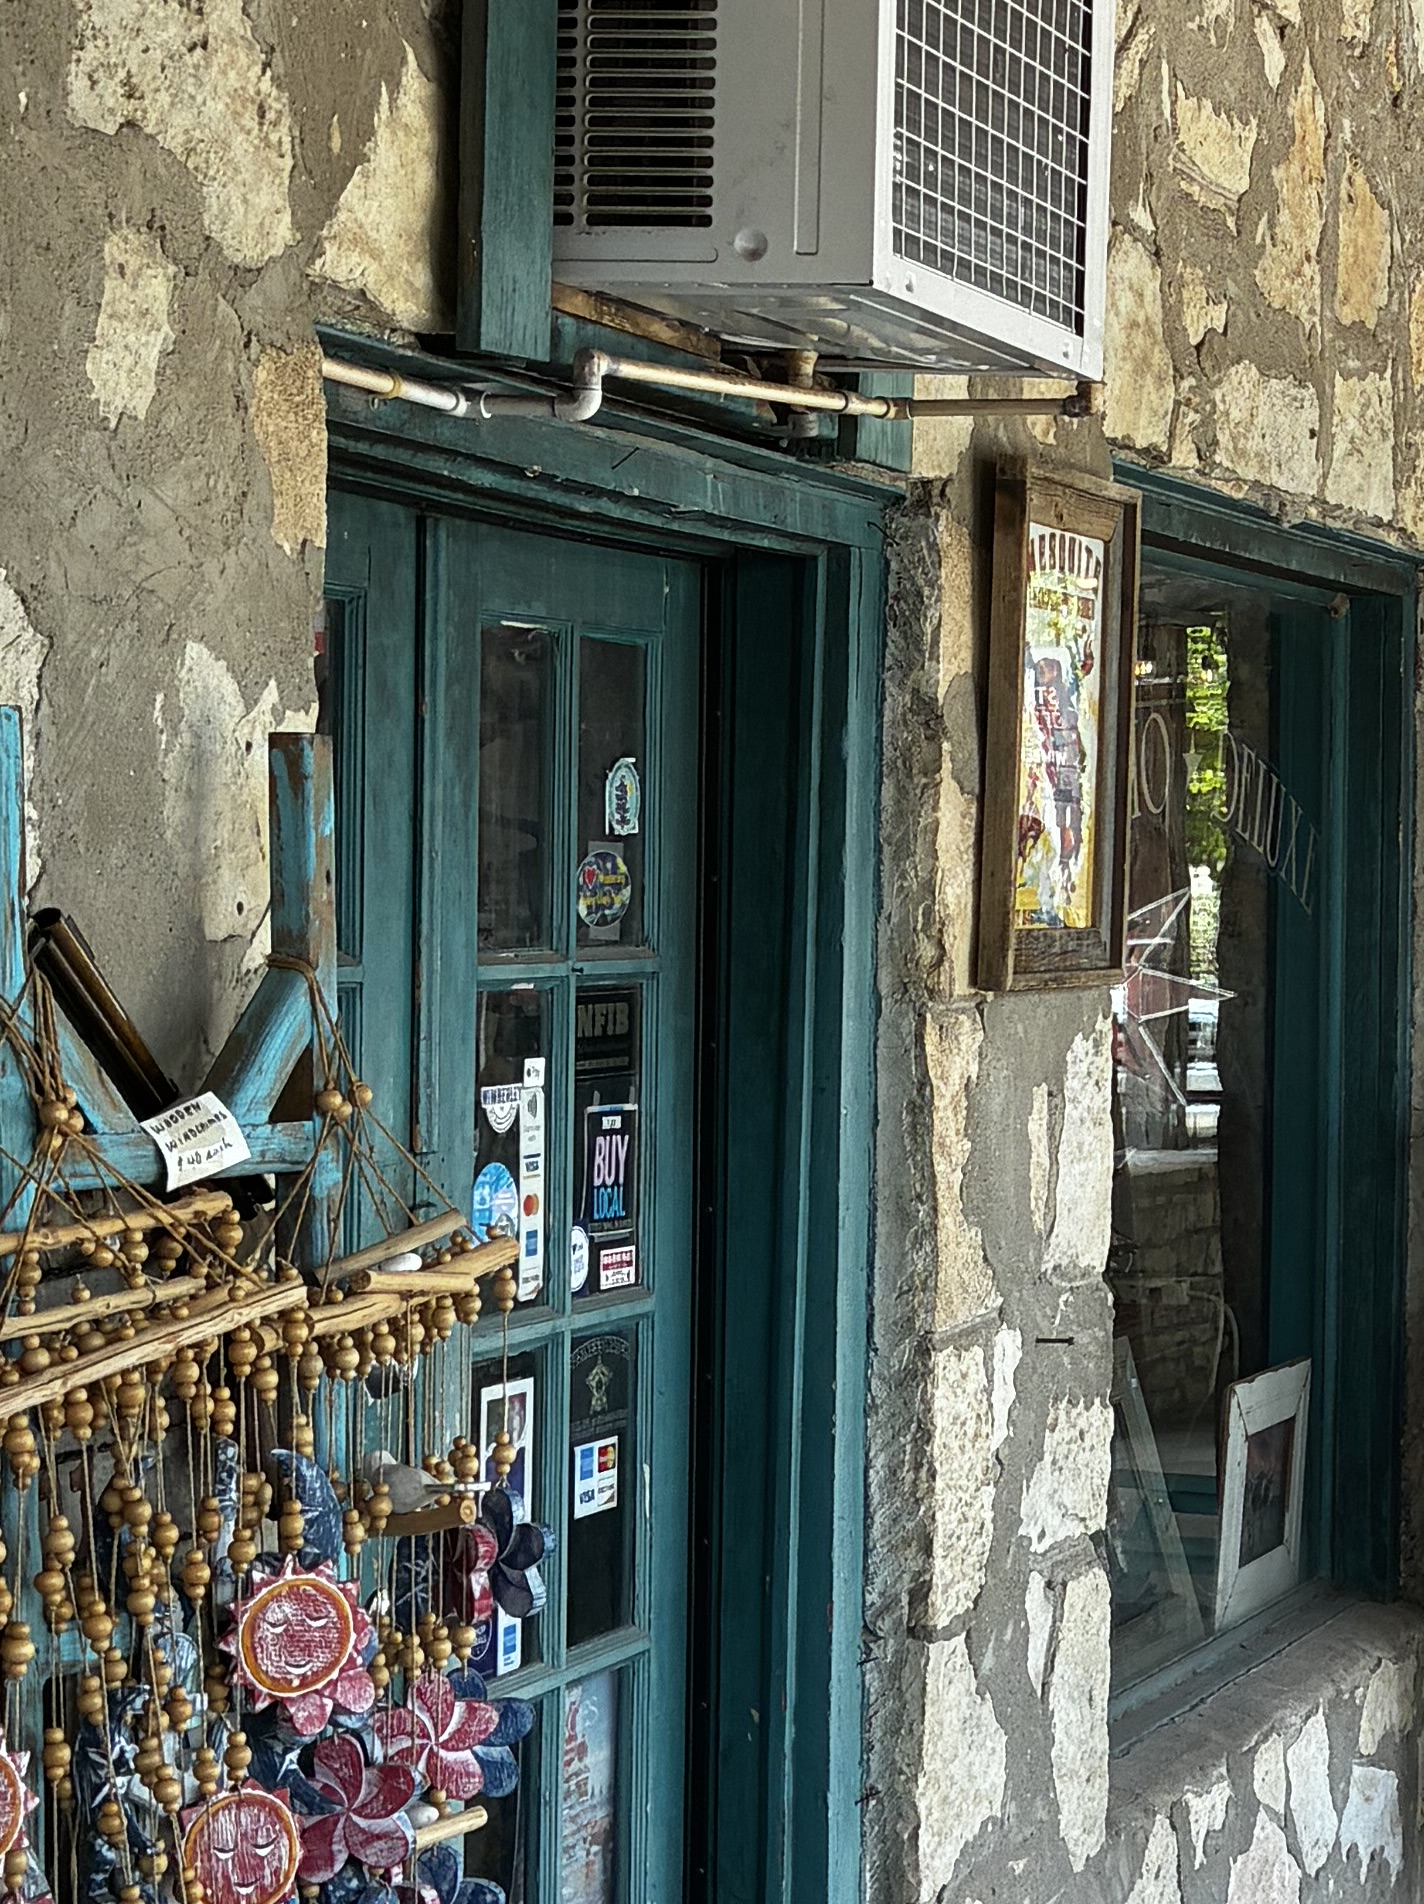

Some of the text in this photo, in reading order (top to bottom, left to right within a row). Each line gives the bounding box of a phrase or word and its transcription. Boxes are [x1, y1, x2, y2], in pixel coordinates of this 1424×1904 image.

[1210, 730, 1321, 920] DELUXE
[576, 1002, 630, 1038] NFIB
[149, 1101, 202, 1135] WOODEN
[593, 1134, 630, 1187] BUY
[592, 1185, 627, 1220] LOCAL
